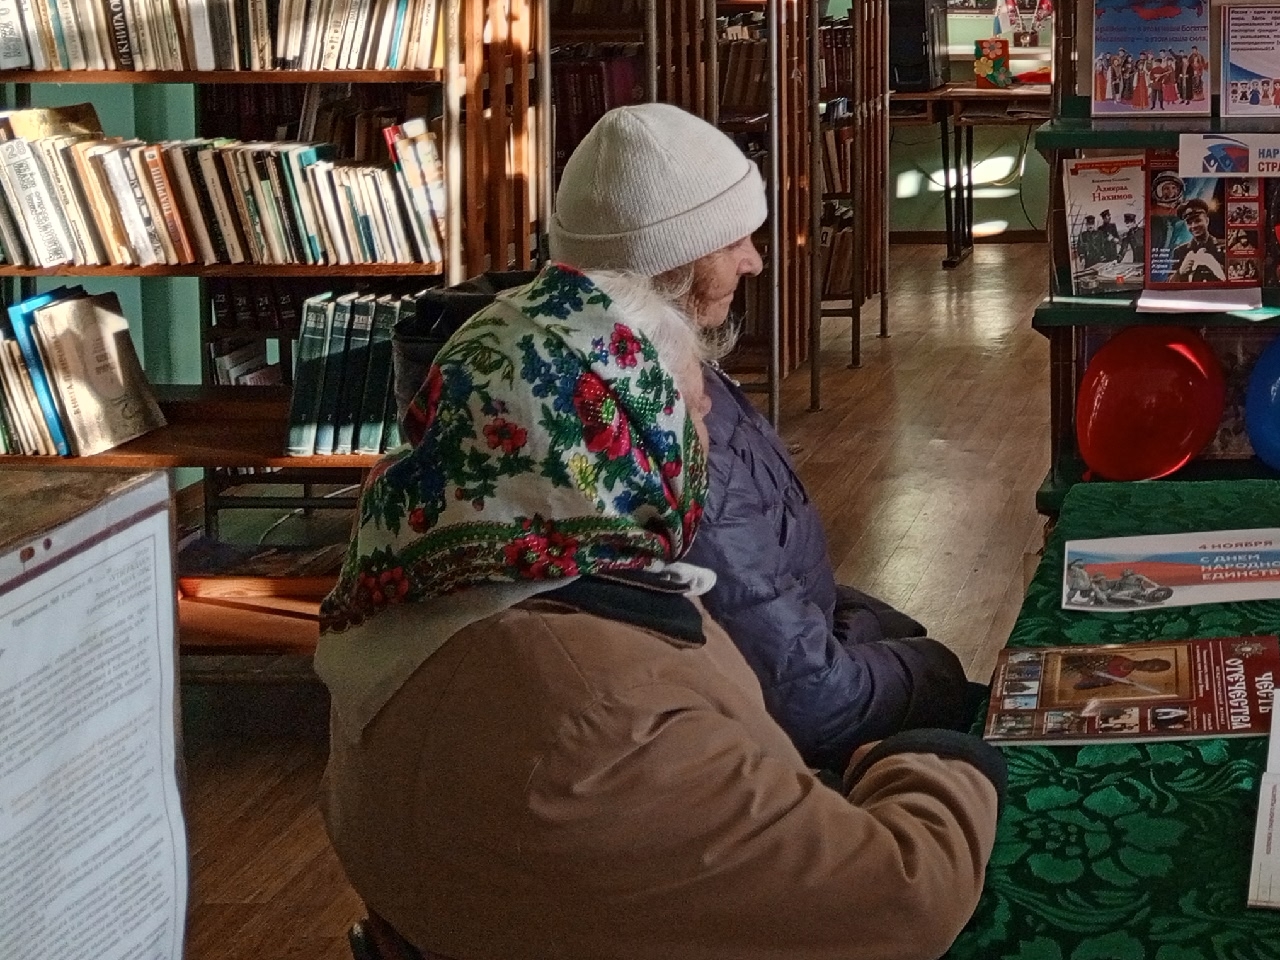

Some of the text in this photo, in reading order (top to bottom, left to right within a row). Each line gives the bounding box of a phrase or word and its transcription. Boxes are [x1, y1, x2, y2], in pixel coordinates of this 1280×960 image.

[112, 12, 129, 53] КНИГА
[7, 141, 27, 159] 28
[1092, 193, 1133, 202] Нахимов
[1211, 540, 1273, 549] НОЯБРЯ
[1213, 554, 1260, 563] ДНЕМ
[1225, 658, 1252, 730] ОТЕЧЕСТВА
